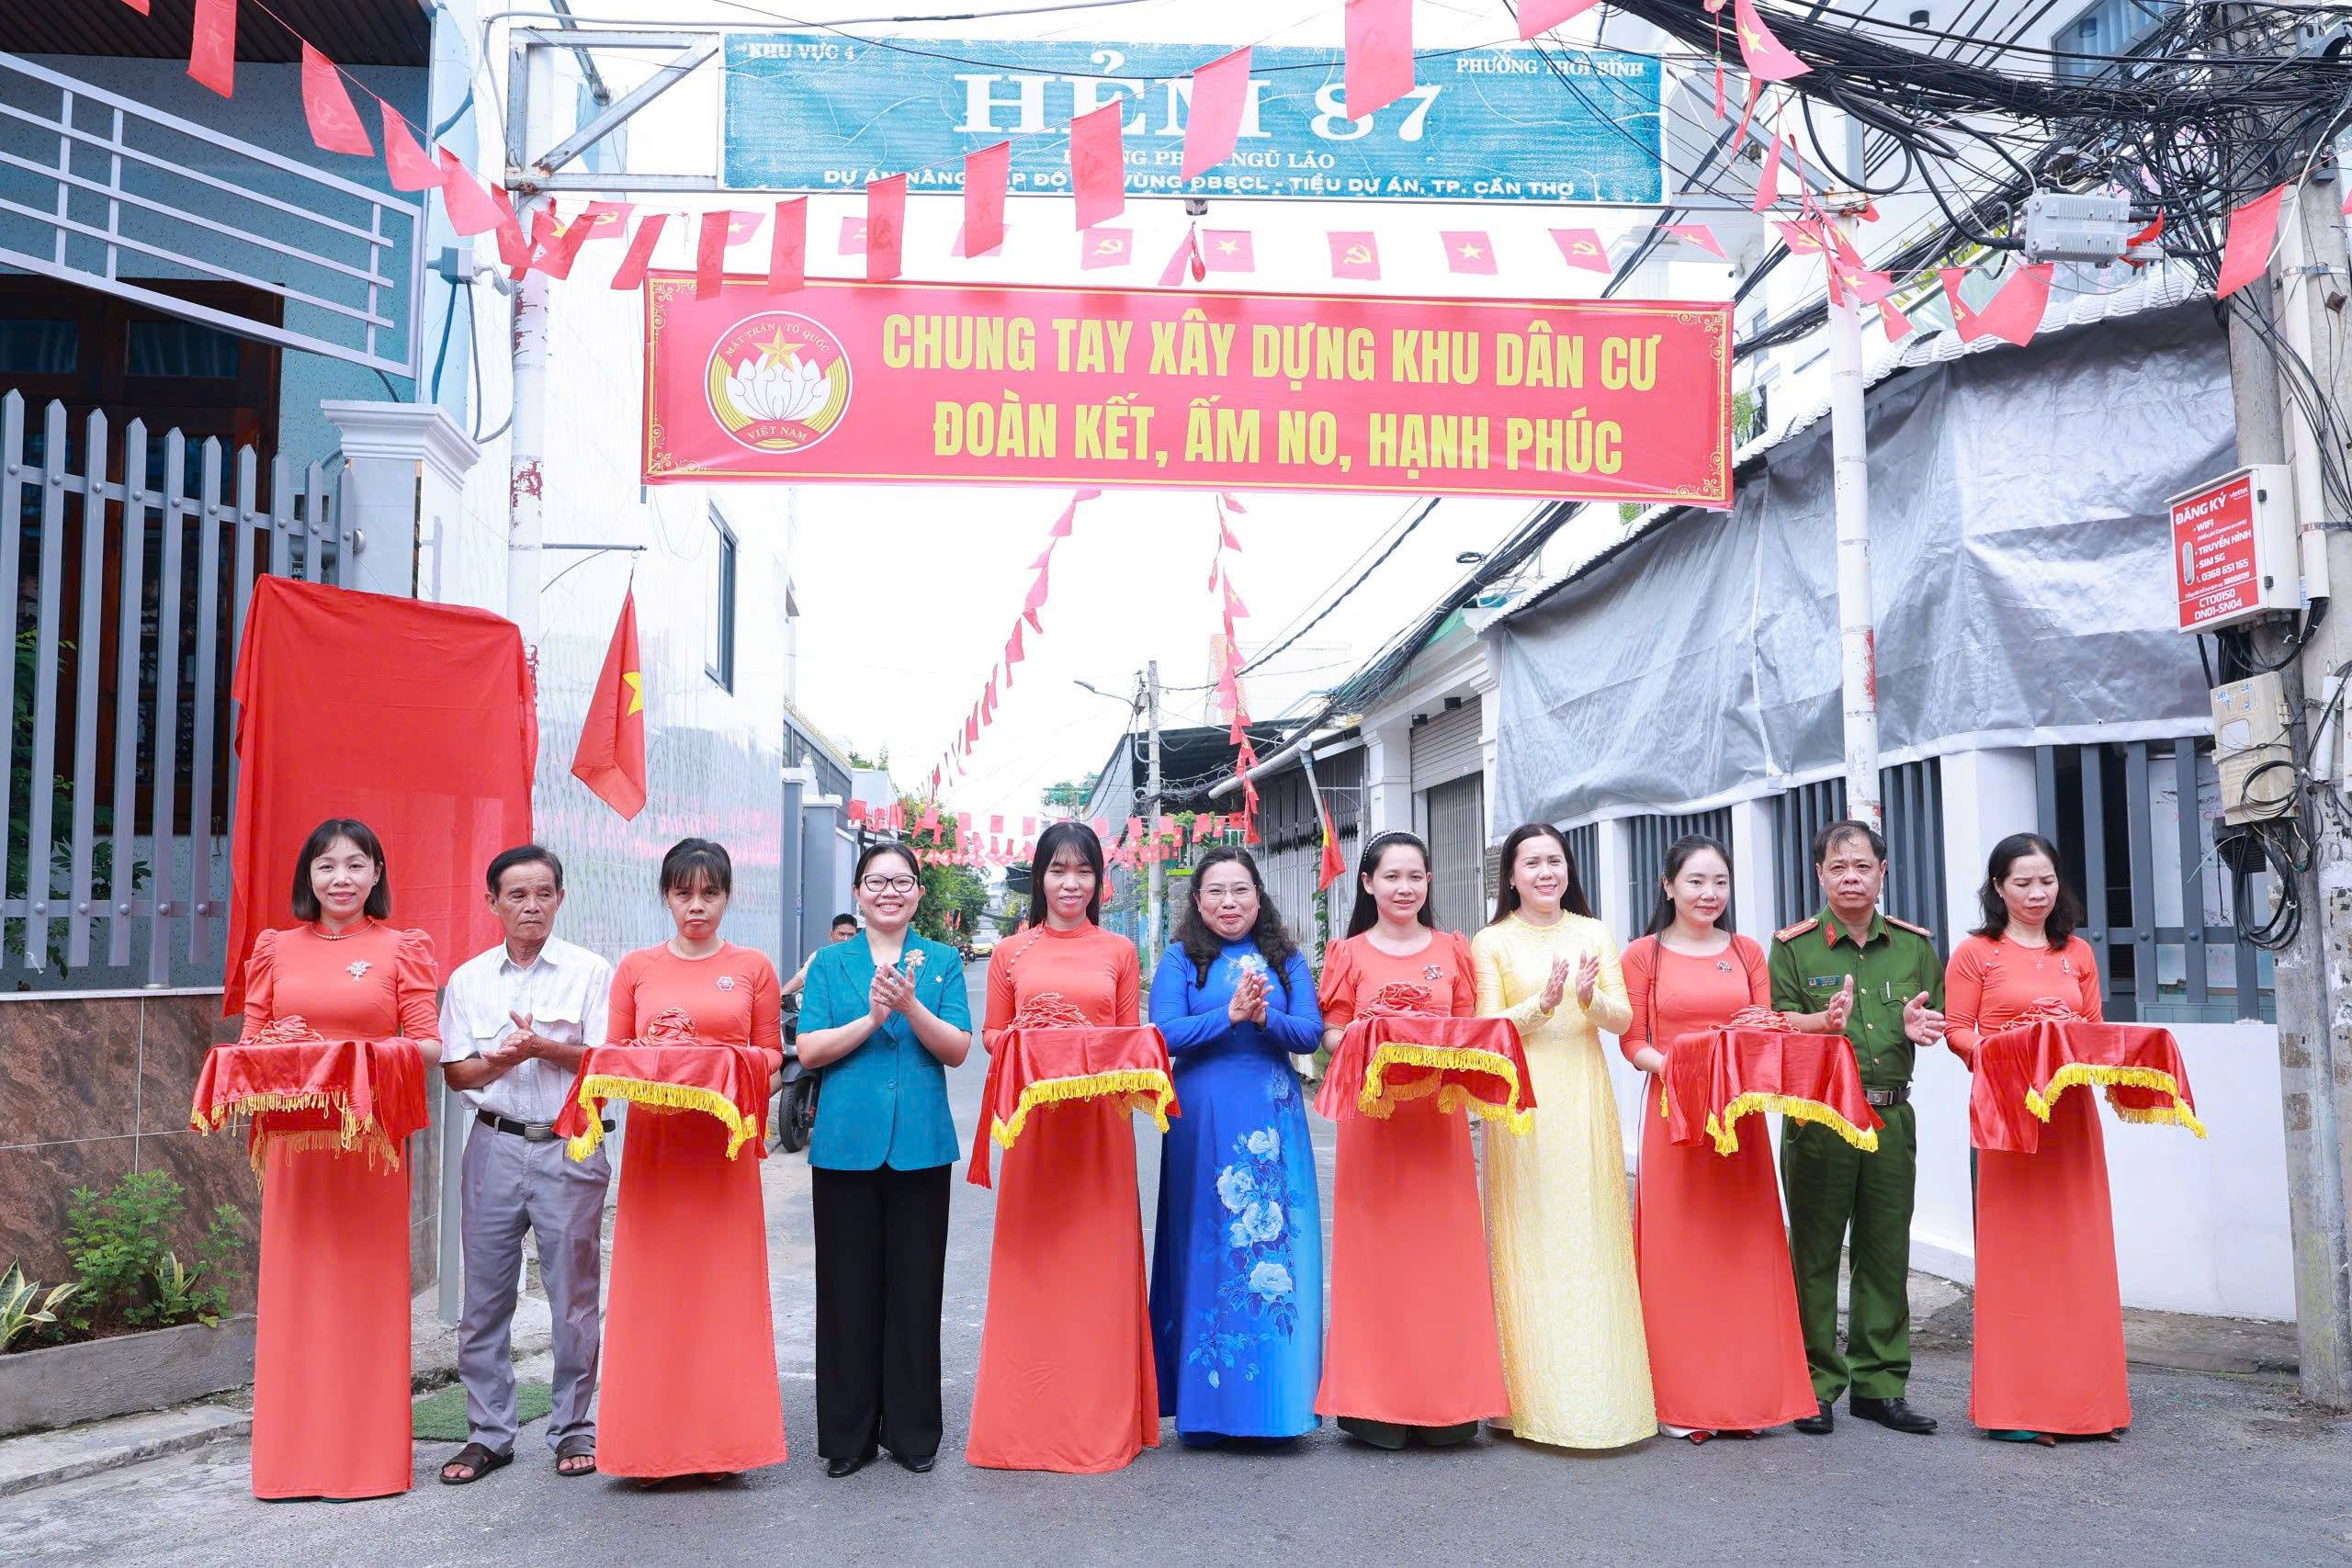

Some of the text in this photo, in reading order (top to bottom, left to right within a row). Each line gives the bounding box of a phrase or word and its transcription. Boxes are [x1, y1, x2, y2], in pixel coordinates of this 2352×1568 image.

[750, 43, 792, 59] KHU
[1310, 83, 1442, 142] 87
[1231, 149, 1282, 167] NGŨ
[1286, 150, 1336, 169] LÃO
[823, 169, 859, 186] DỰ
[1288, 173, 1341, 191] TIỂU
[1348, 177, 1382, 193] DỰ
[1431, 179, 1466, 193] TP.
[1526, 181, 1576, 196] THƠ
[744, 322, 776, 338] TRẬN
[802, 330, 831, 354] QUỐC
[884, 309, 1661, 390] CHUNG TAY XÂY DỰNG KHU DÂN CƯ
[748, 425, 808, 441] VIỆT NAM
[933, 389, 1622, 479] ĐOÀN KẾT, ẤM NO, HẠNH PHÚC
[2175, 502, 2209, 525] ĐĂNG
[2209, 491, 2227, 513] KÝ
[2199, 557, 2214, 570] SIM
